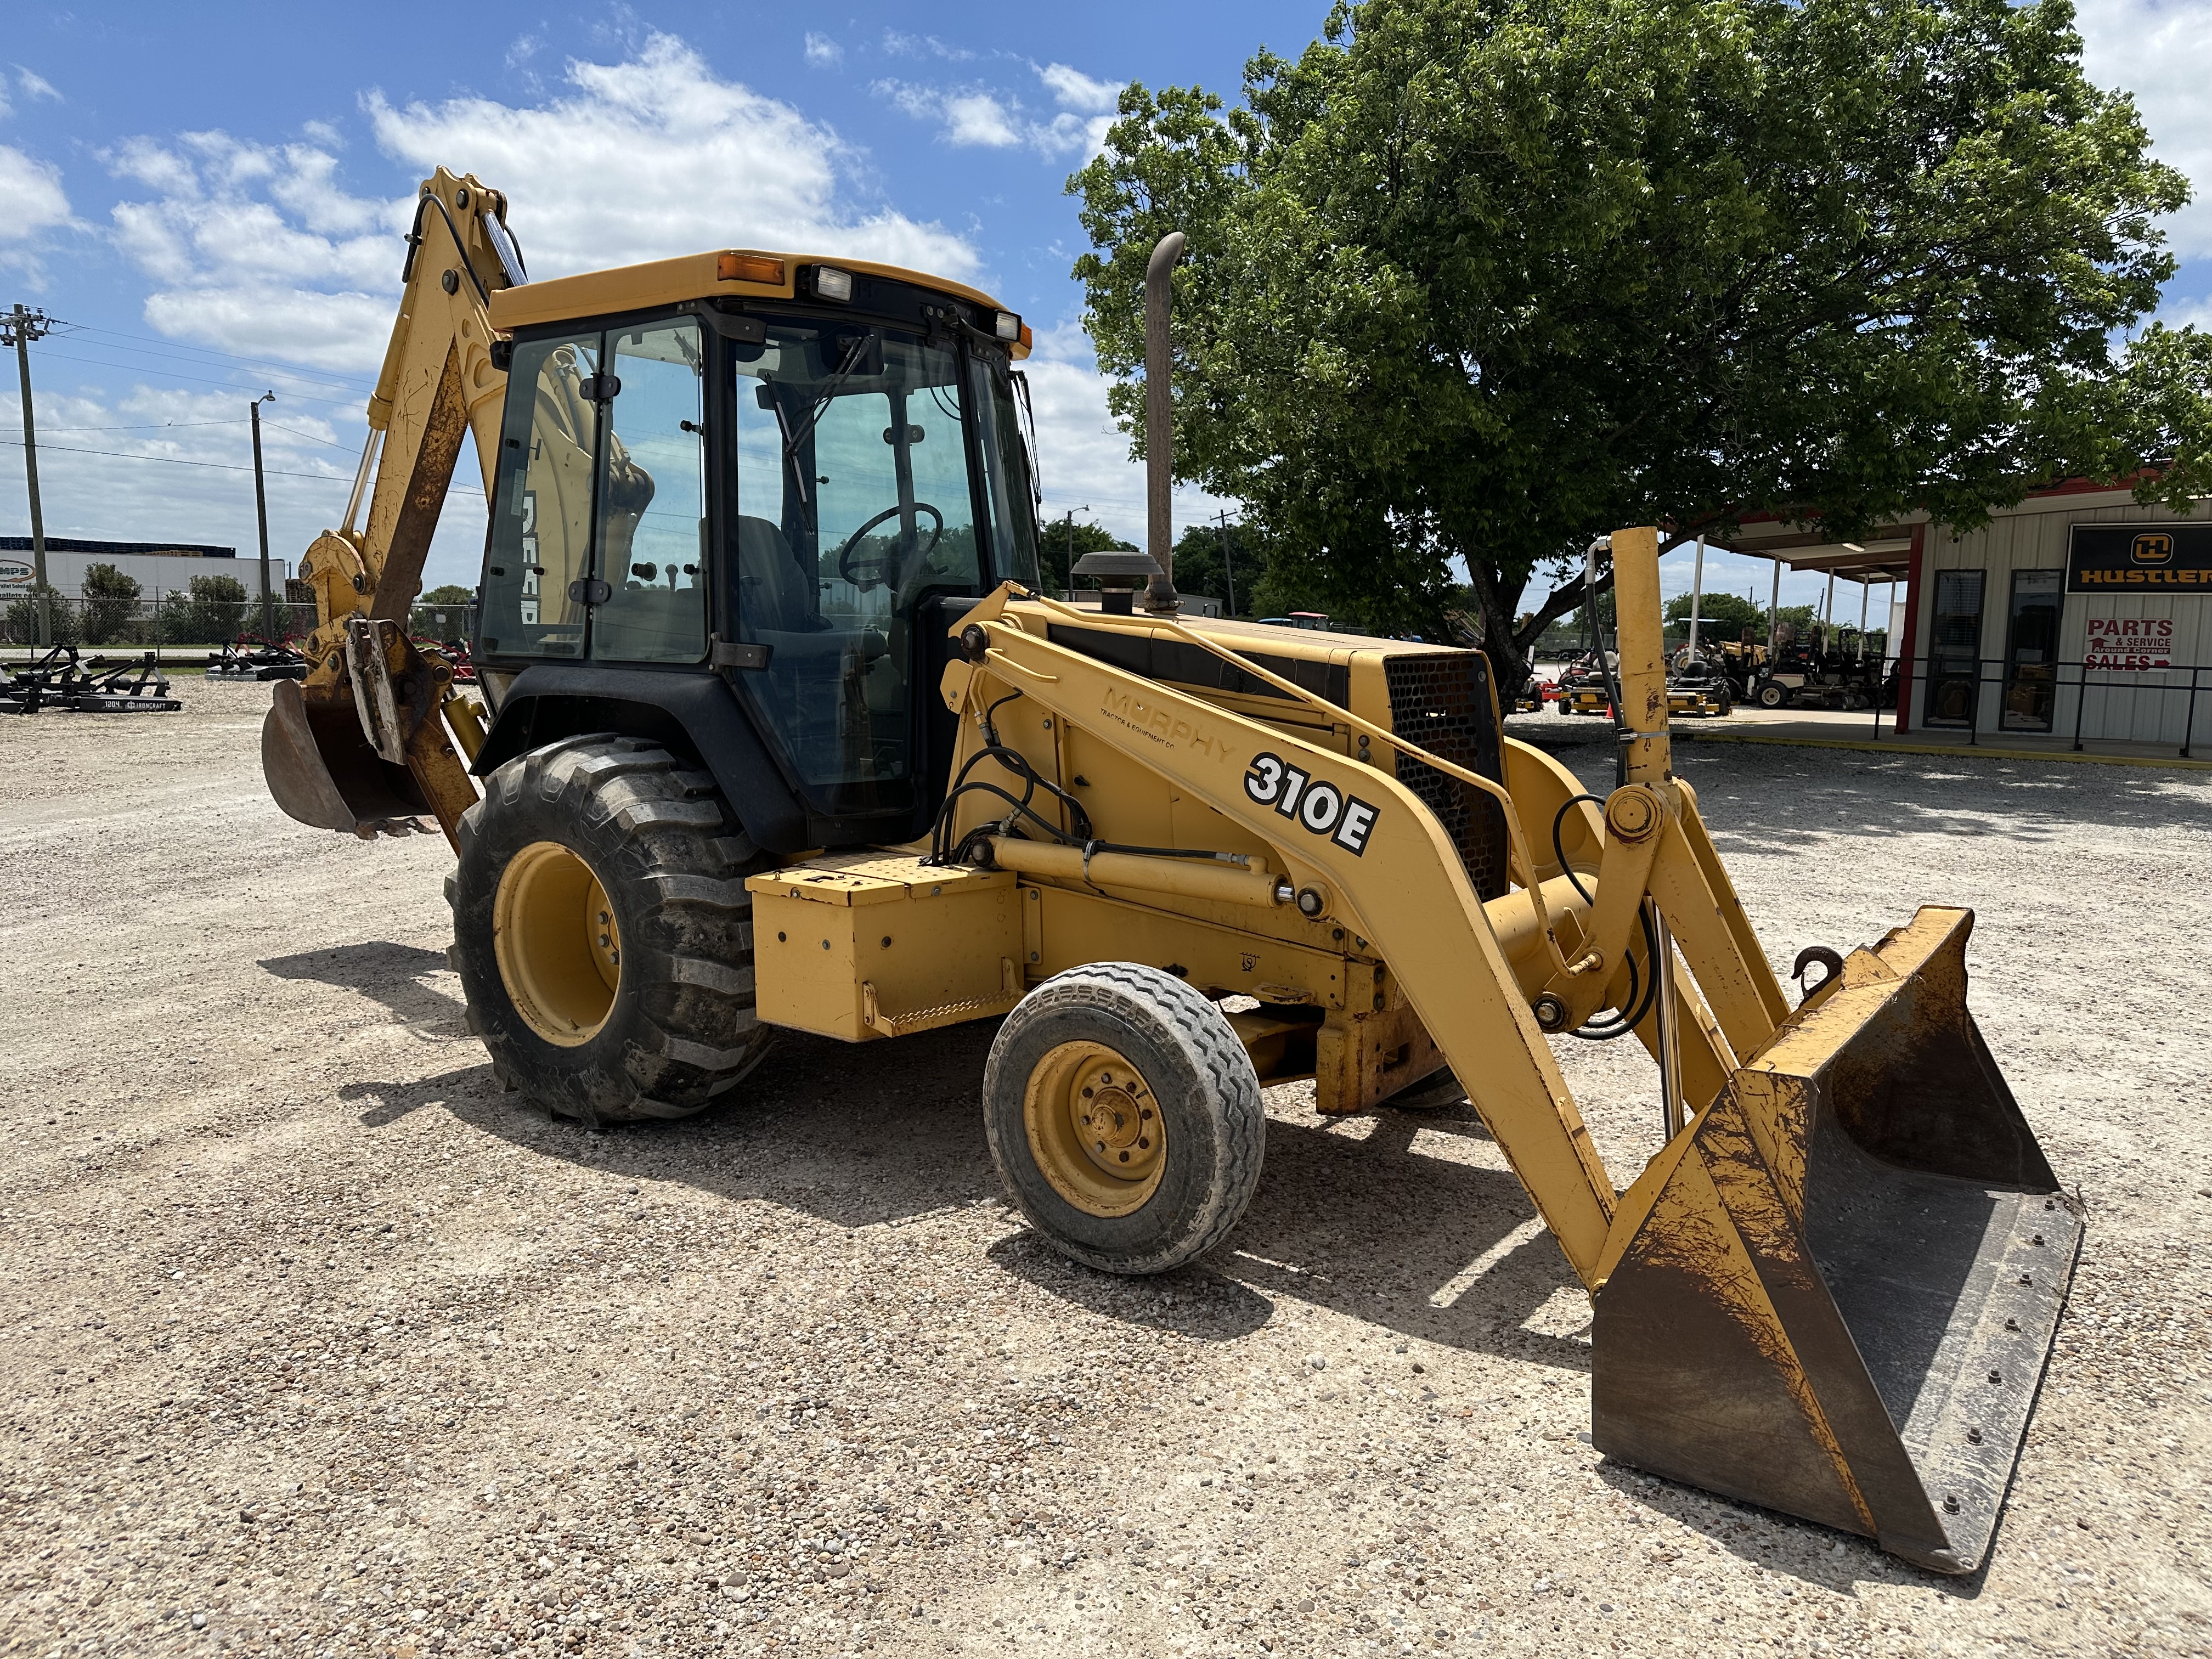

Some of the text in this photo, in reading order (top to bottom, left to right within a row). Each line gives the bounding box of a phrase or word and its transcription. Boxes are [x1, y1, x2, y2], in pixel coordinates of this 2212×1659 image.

[2081, 570, 2212, 583] HUSTLER
[2088, 620, 2173, 636] PARTS
[2115, 637, 2171, 647] & SERVICE
[2086, 654, 2150, 671] SALES
[1101, 708, 1126, 725] TRACTOR
[1131, 724, 1165, 746] EQUIPMENT
[1103, 685, 1238, 764] MURPHY
[1244, 752, 1381, 858] 310E
